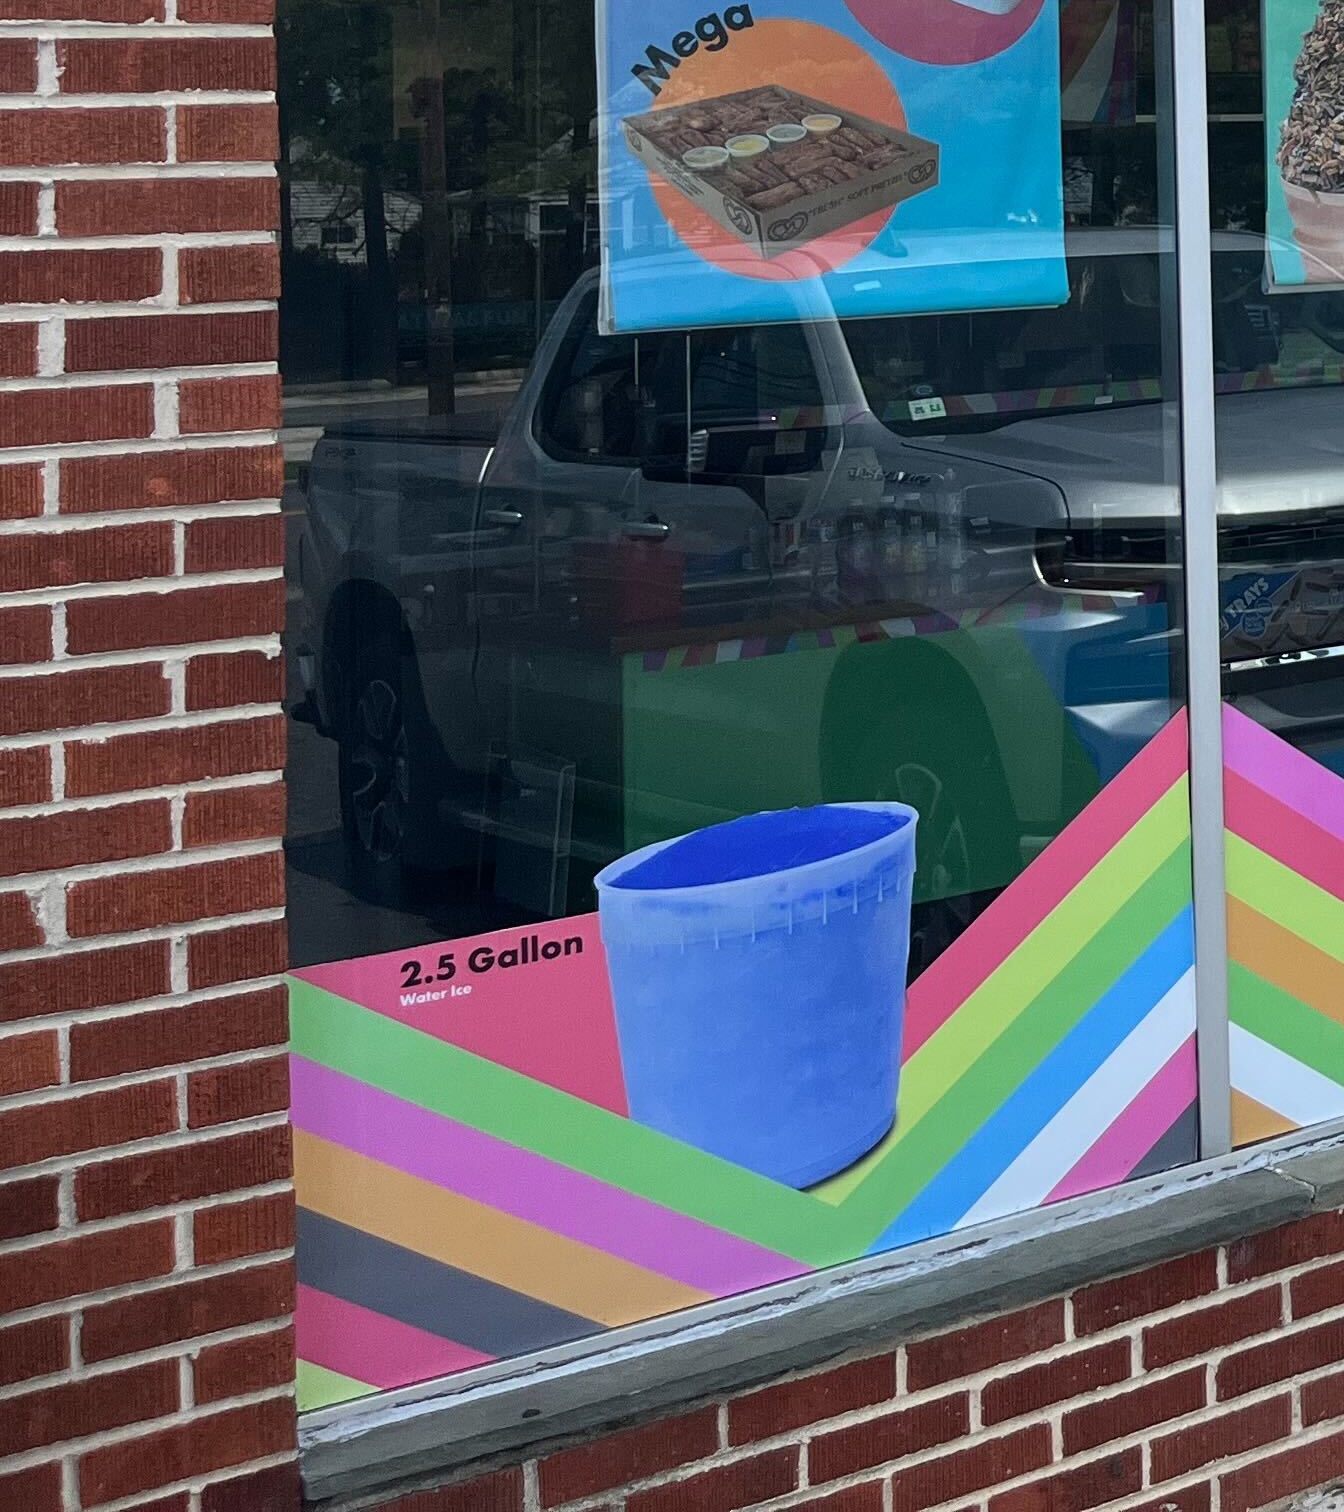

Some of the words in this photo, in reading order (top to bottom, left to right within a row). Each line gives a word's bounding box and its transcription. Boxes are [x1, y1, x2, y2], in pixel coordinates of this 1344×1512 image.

[630, 3, 755, 96] Mega
[400, 953, 456, 988] 2.5
[468, 935, 583, 974] Gallon
[400, 990, 447, 1007] Water
[451, 984, 472, 998] Ice
